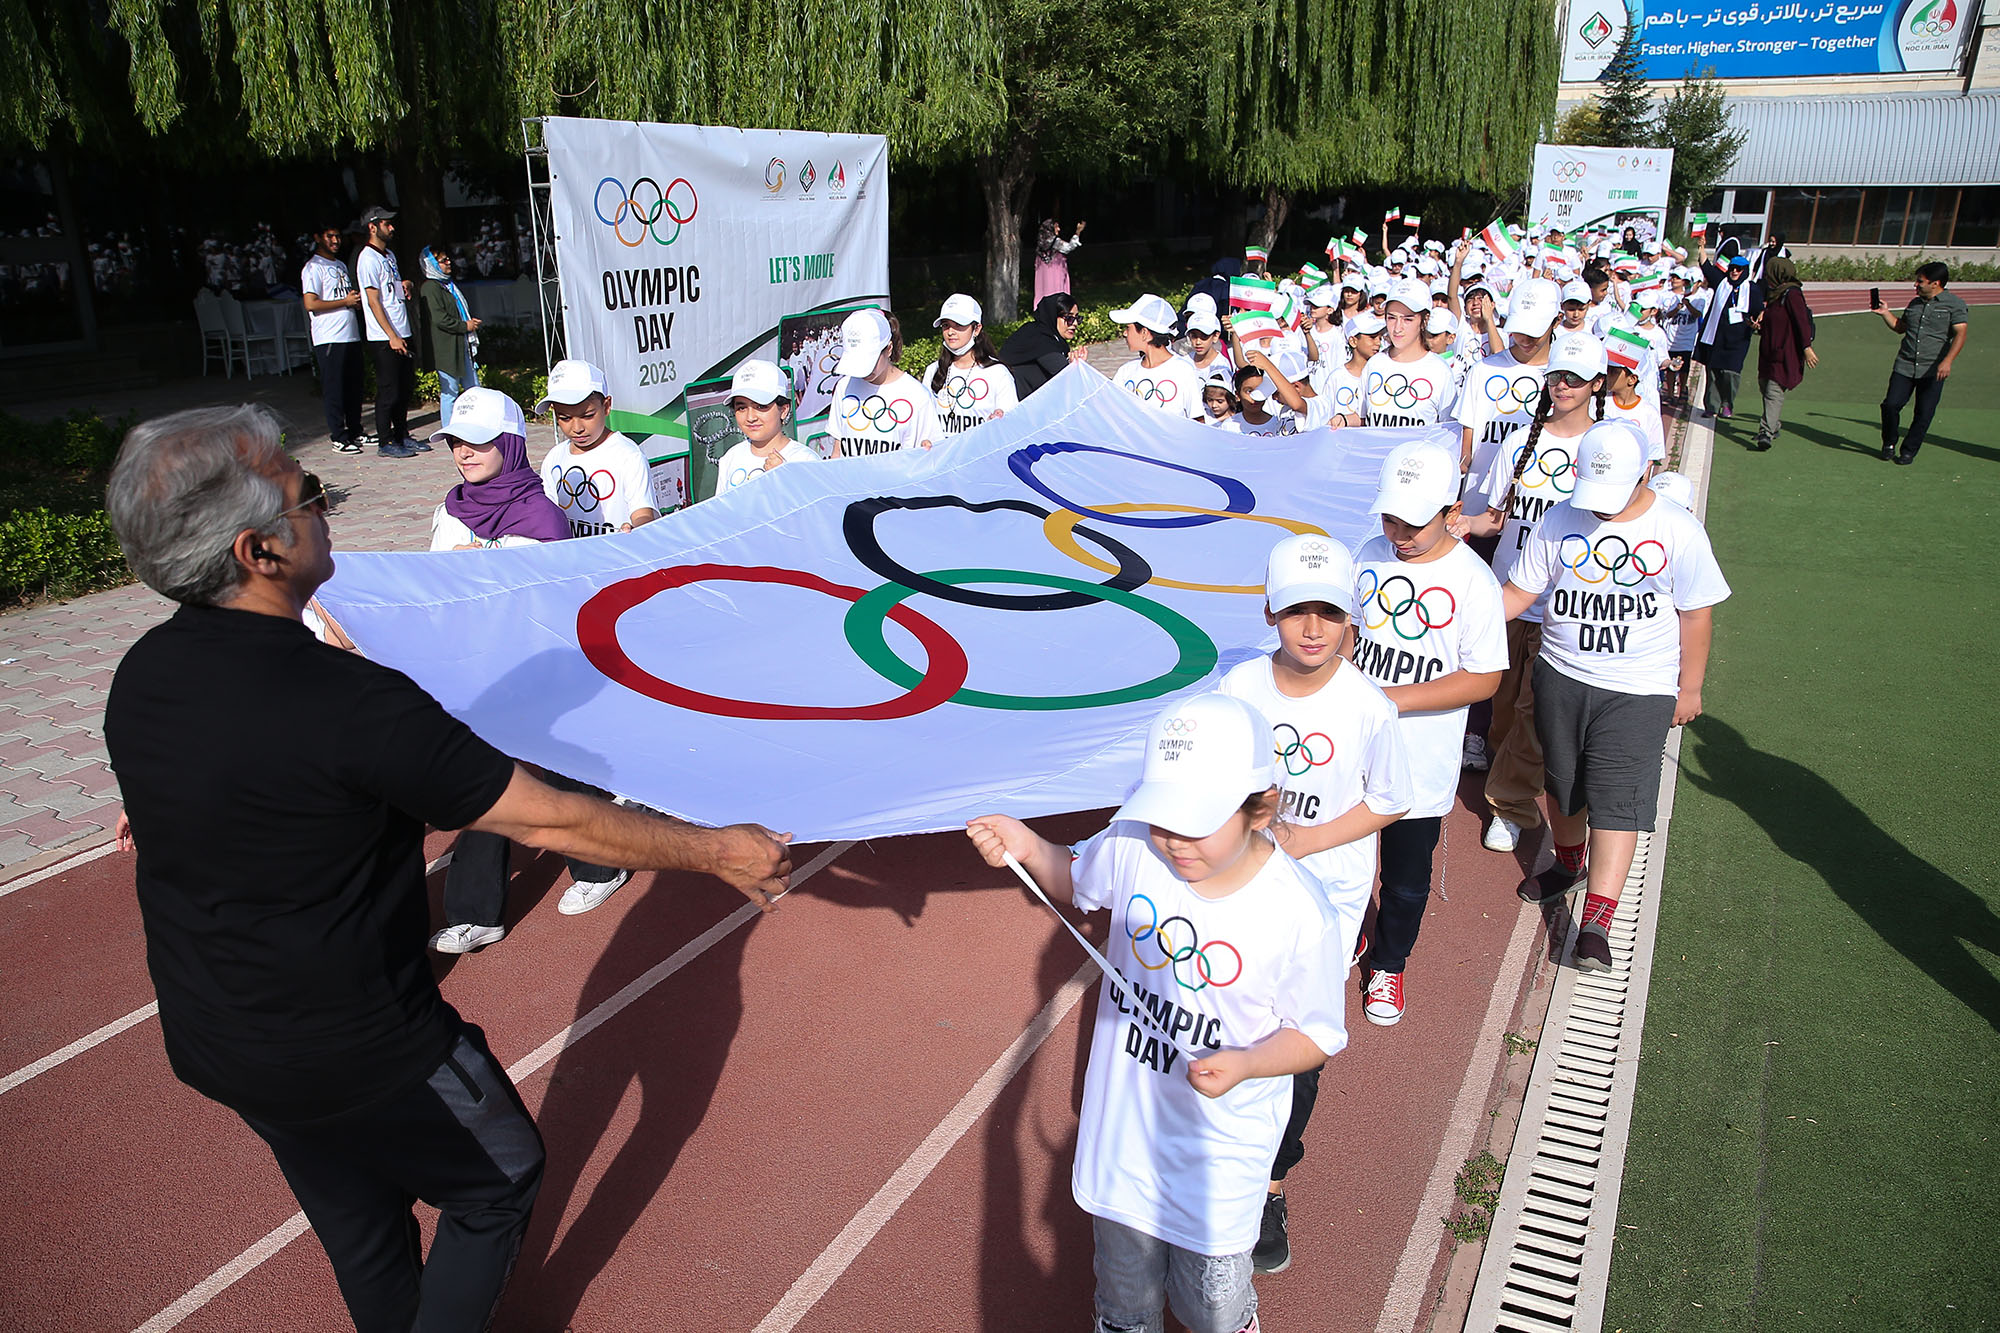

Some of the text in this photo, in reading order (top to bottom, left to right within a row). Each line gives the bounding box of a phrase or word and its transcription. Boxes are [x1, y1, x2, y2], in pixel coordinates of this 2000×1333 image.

[1641, 43, 1685, 55] Faster,
[1687, 41, 1734, 57] Higher,
[1736, 40, 1798, 54] Stronger
[1810, 35, 1877, 52] Together
[1549, 189, 1583, 202] OLYMPIC
[1608, 189, 1639, 200] LET'S MOVE
[1557, 204, 1573, 217] DAY
[769, 252, 835, 284] LET'S MOVE
[602, 265, 700, 311] OLYMPIC
[634, 312, 675, 354] DAY
[640, 360, 677, 387] 2023
[1397, 469, 1421, 480] OLYMPIC
[1400, 476, 1412, 484] DAY
[1300, 555, 1329, 564] OLYMPIC
[1554, 589, 1658, 621] OLYMPIC
[1579, 623, 1629, 653] DAY
[1159, 739, 1194, 751] OLYMPIC
[1164, 751, 1181, 761] DAY
[1125, 1022, 1180, 1075] DAY
